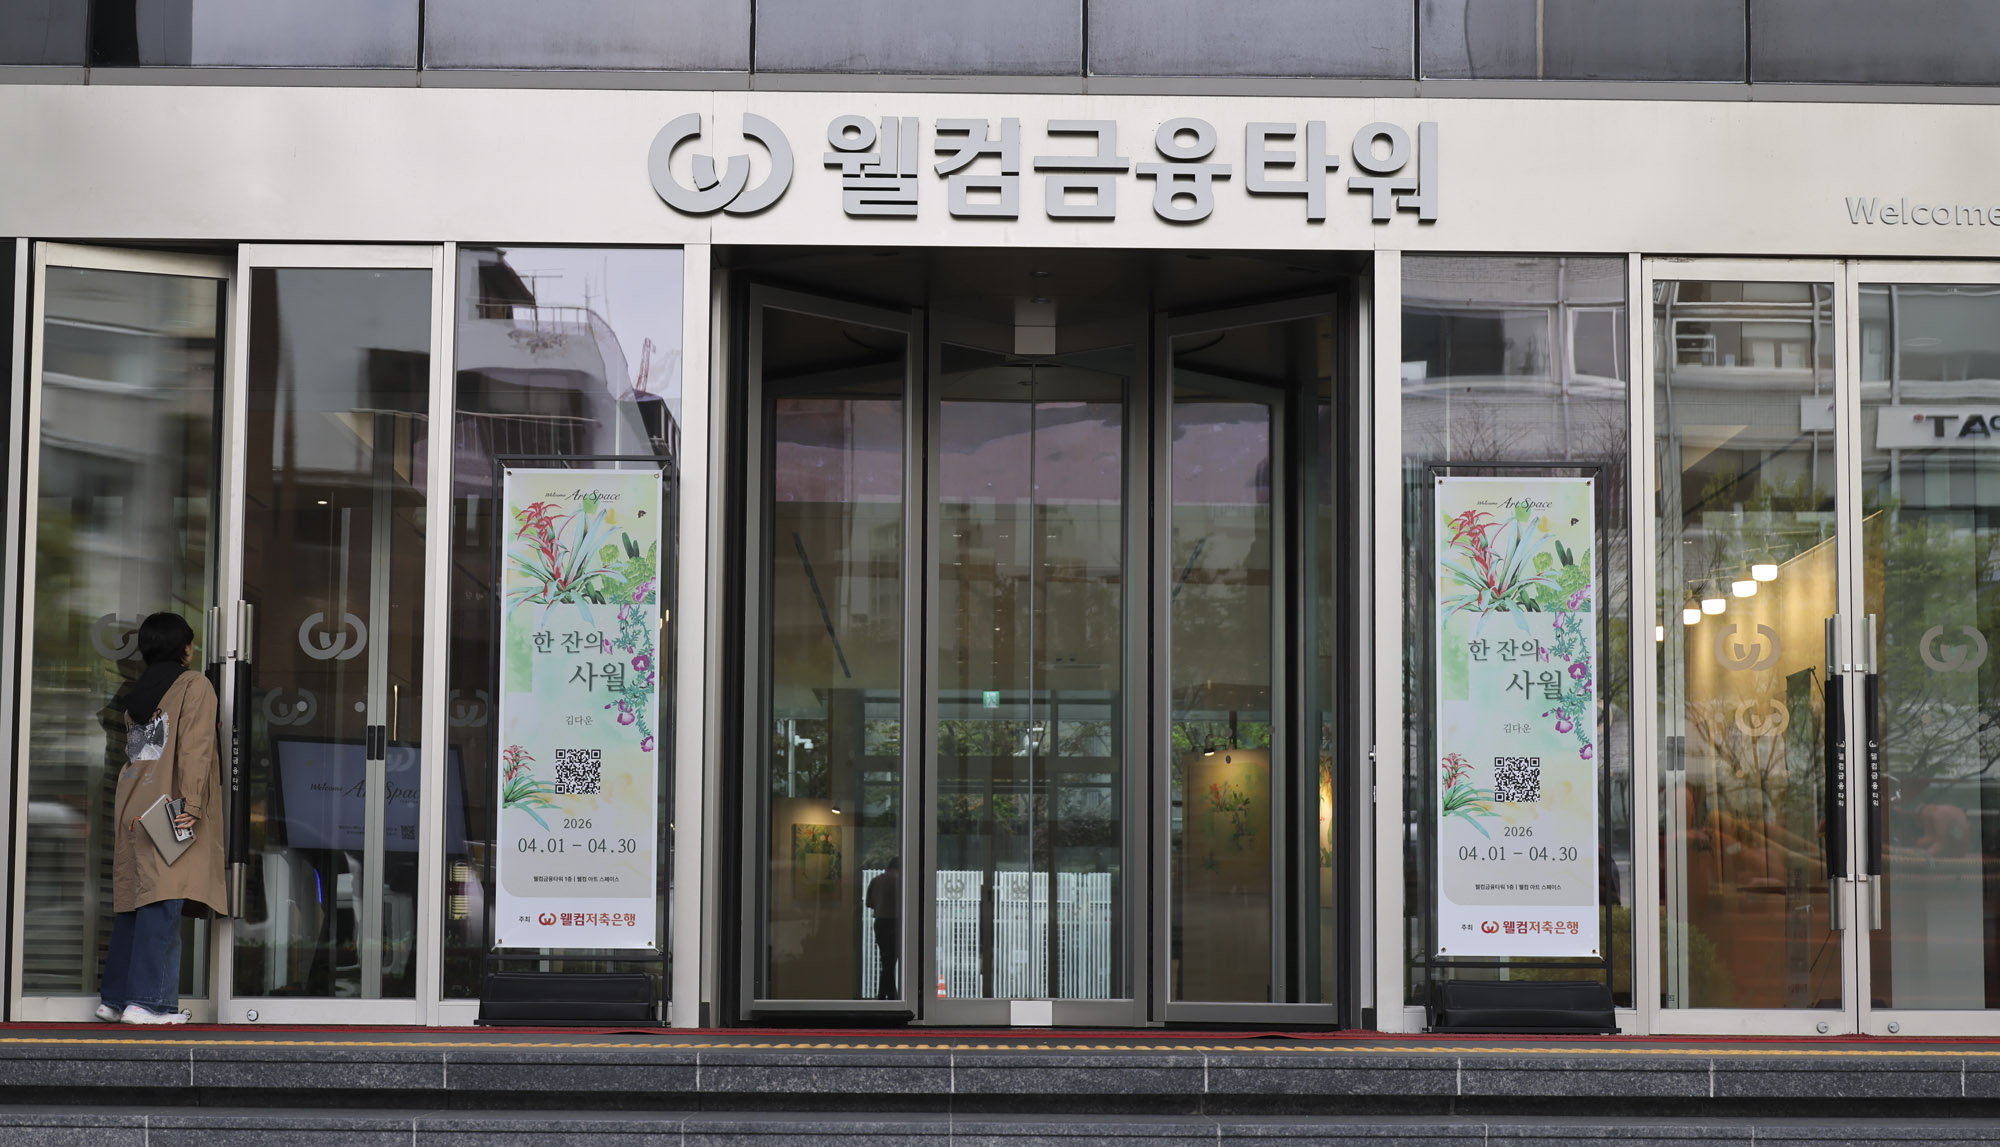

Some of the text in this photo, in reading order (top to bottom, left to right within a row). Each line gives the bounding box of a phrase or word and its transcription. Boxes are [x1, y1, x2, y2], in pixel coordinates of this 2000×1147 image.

[823, 114, 1440, 224] 웰컴금융타워
[1845, 197, 2000, 227] Welcome
[565, 489, 588, 500] Art
[589, 489, 621, 504] Space
[1497, 496, 1520, 509] Art
[1521, 497, 1553, 512] Space
[532, 630, 605, 654] 한 잔의
[1468, 638, 1540, 662] 한 잔의
[569, 662, 628, 694] 사월
[1506, 669, 1563, 702] 사월
[565, 715, 593, 726] 김다운
[1503, 723, 1531, 734] 김다운
[563, 818, 593, 830] 2026
[1504, 826, 1533, 838] 2026
[518, 837, 565, 854] 04.01
[588, 838, 636, 854] 04.30
[1459, 845, 1506, 862] 04.01
[1529, 846, 1577, 862] 04.30
[518, 912, 636, 927] 주최 웰컴저축은행
[1460, 920, 1579, 935] 주최 웰컴저축은행
